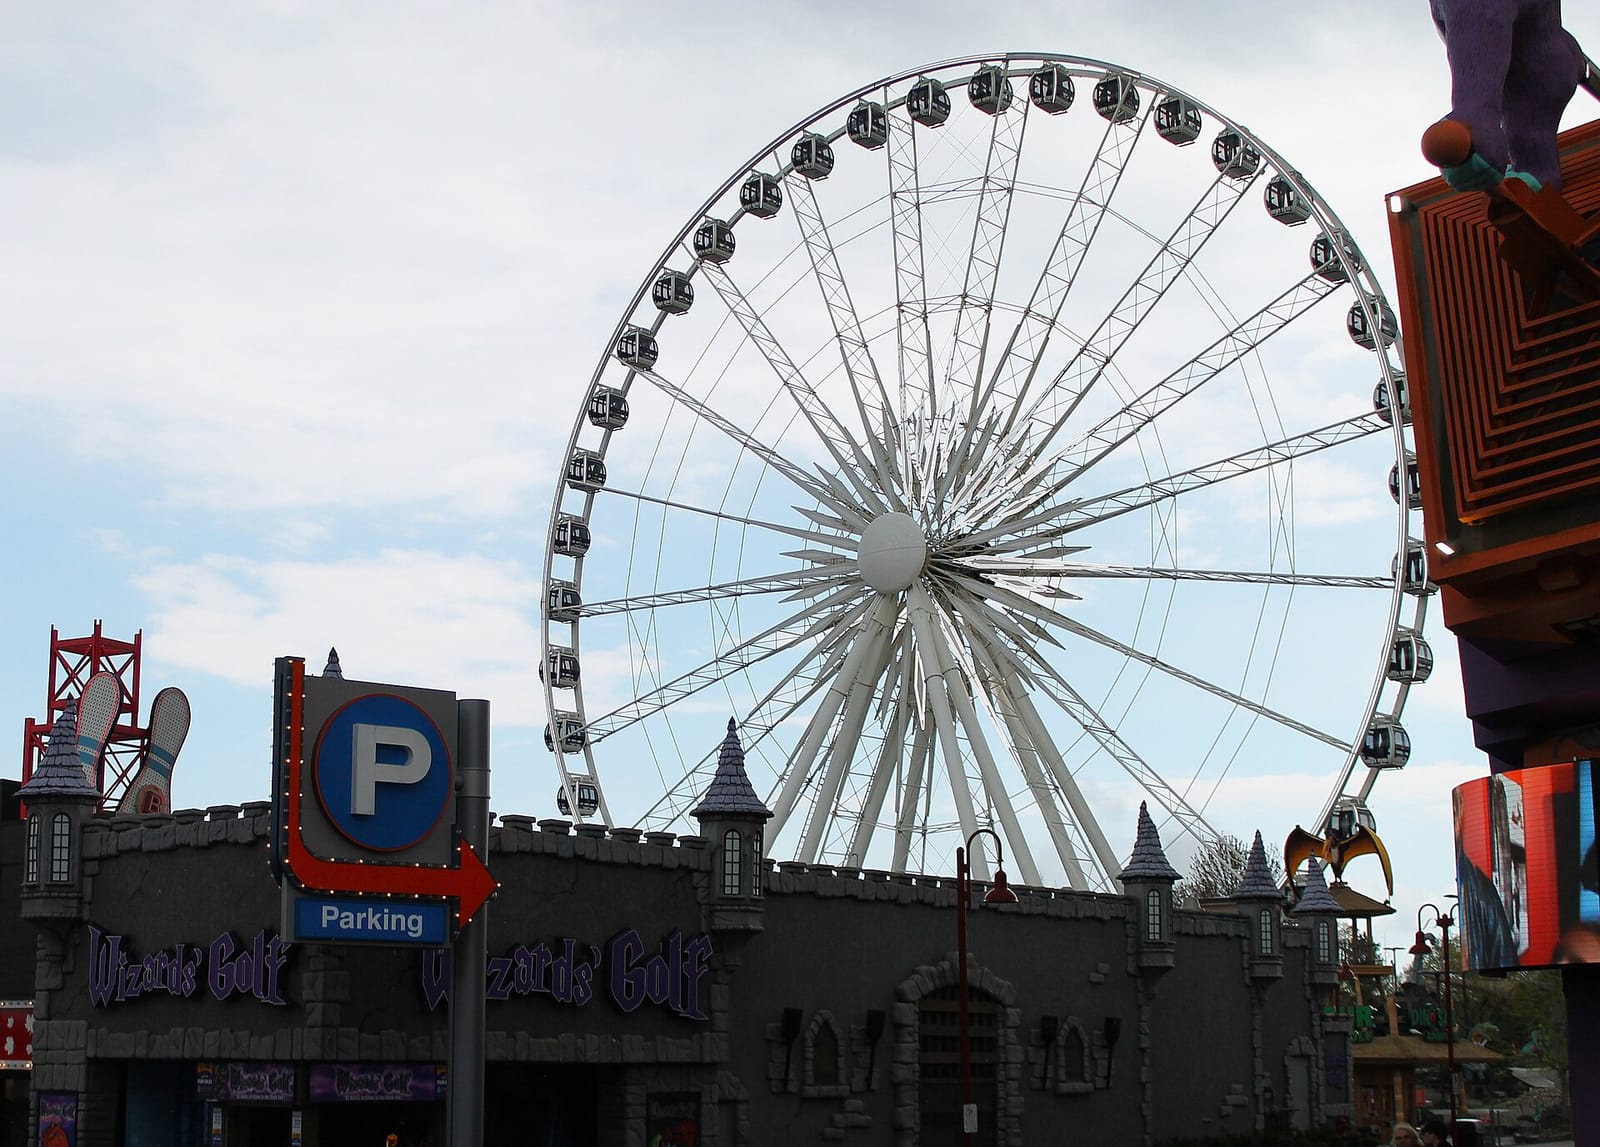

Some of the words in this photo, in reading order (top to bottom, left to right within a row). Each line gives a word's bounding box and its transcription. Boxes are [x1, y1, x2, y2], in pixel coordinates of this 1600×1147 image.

[351, 723, 432, 816] P
[321, 905, 424, 937] Parking
[88, 925, 202, 1008] Wizards'
[208, 929, 291, 1005] Golf
[422, 938, 601, 1012] zards'
[608, 929, 713, 1020] Golf
